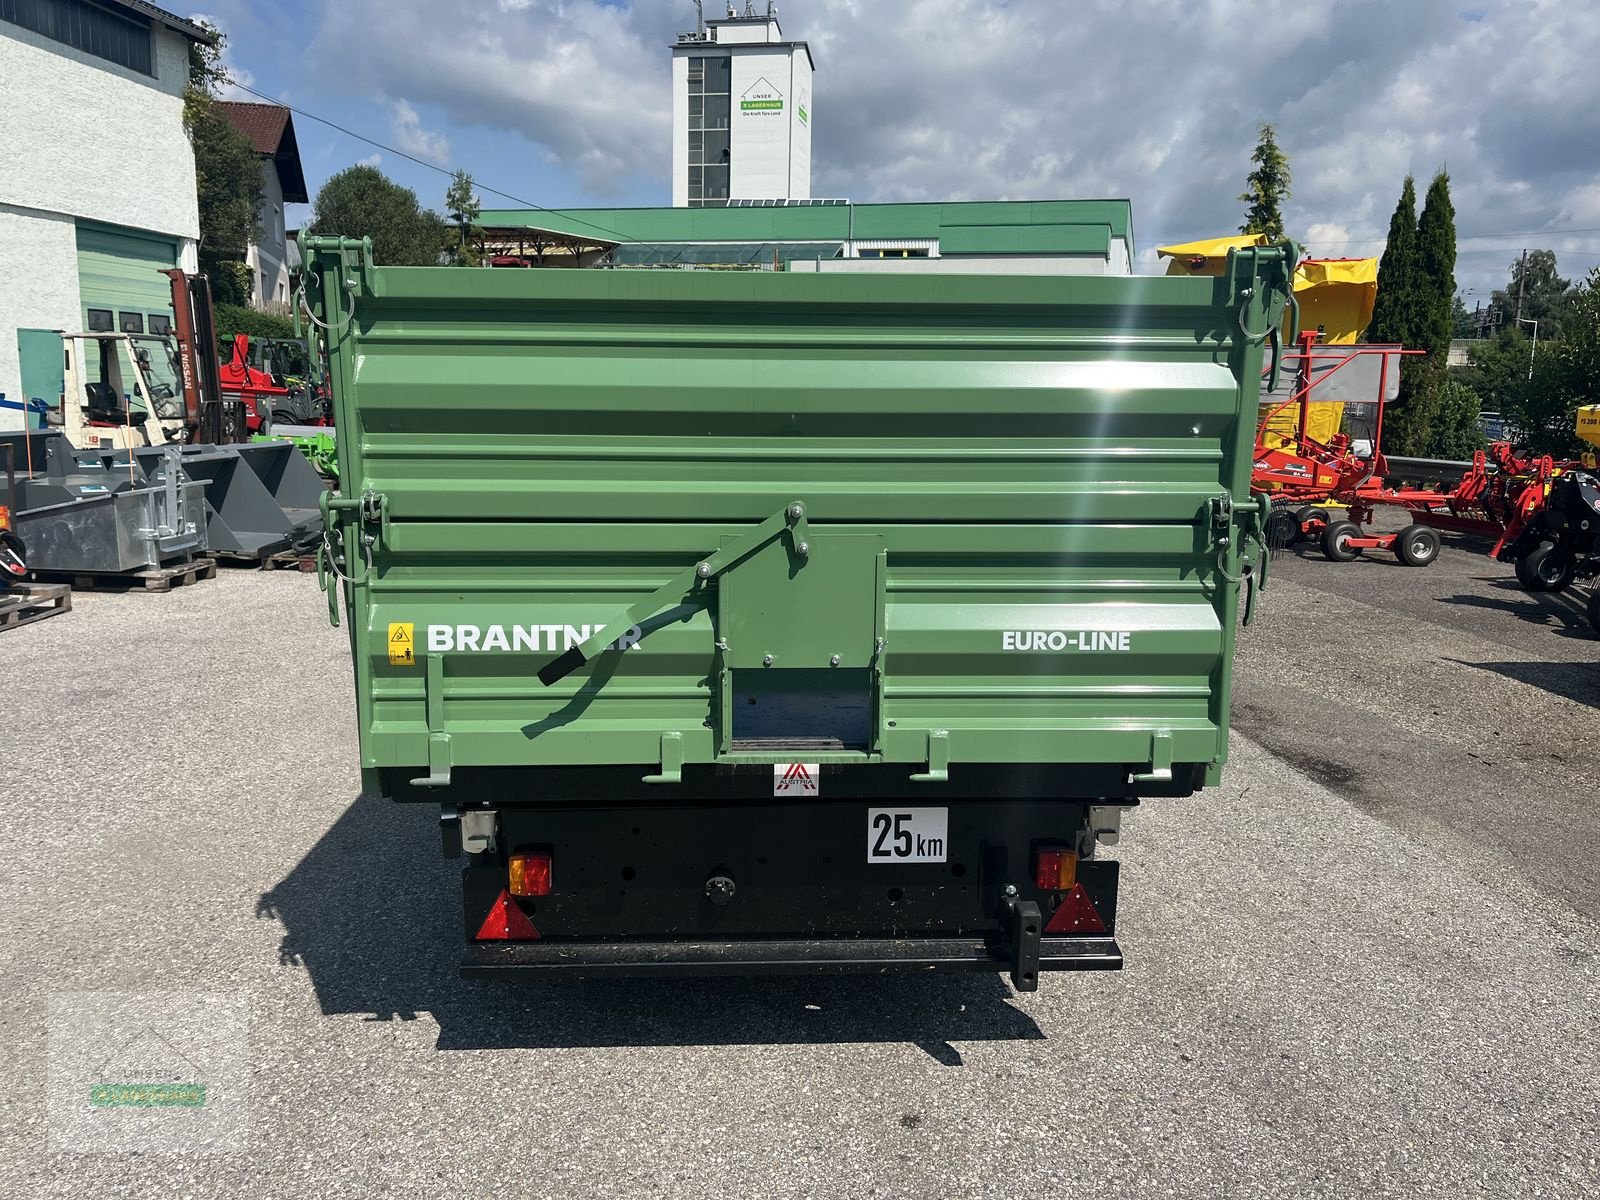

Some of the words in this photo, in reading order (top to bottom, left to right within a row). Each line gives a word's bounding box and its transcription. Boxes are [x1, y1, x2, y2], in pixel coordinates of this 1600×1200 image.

[181, 353, 192, 390] NISSAN
[427, 624, 642, 650] BRANTNR
[1002, 631, 1130, 650] EURO-LINE
[872, 814, 912, 857] 25
[916, 834, 942, 856] km
